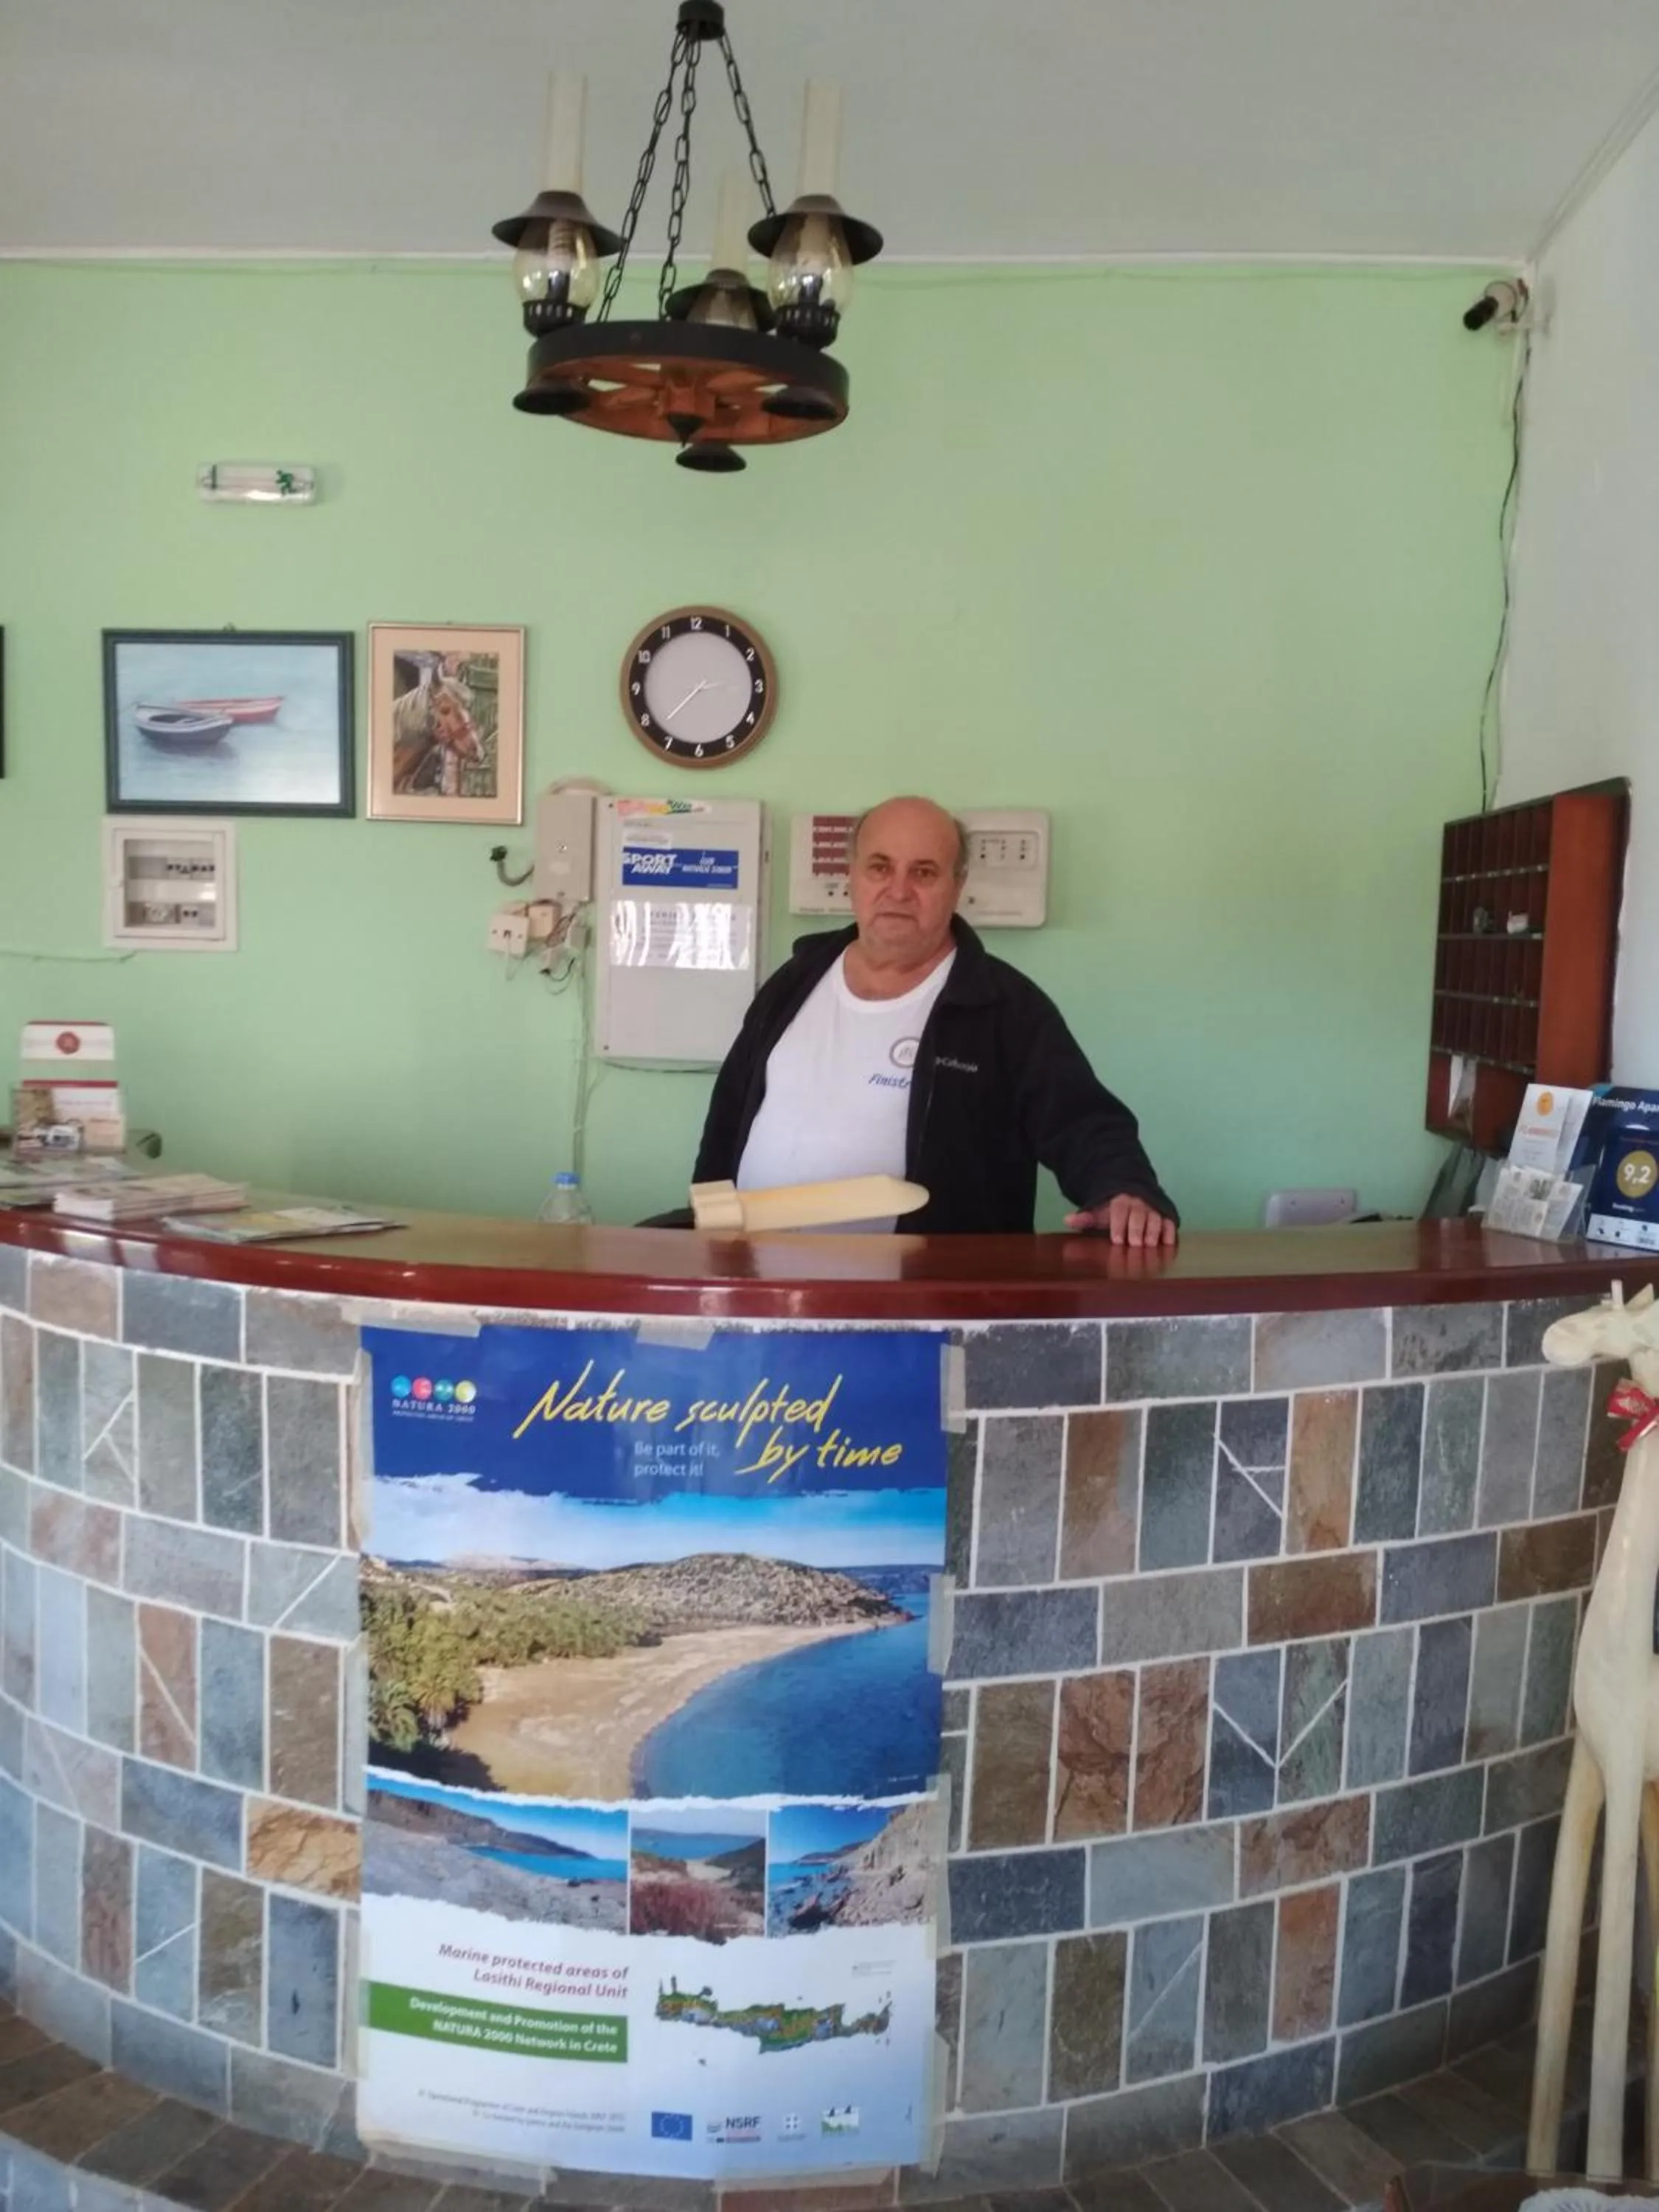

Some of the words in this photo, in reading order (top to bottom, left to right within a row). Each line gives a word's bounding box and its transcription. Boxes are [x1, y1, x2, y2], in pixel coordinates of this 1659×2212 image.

[690, 616, 702, 630] 12
[662, 625, 670, 639] 11
[725, 625, 730, 637] 1
[638, 650, 650, 663] 10
[745, 647, 754, 661] 2
[631, 681, 641, 695] 9
[754, 679, 763, 693] 3
[641, 713, 650, 726] 8
[745, 712, 754, 725] 4
[664, 736, 673, 751] 7
[726, 734, 735, 749] 5
[694, 743, 703, 757] 6
[1624, 1163, 1652, 1184] 9,2
[392, 1398, 444, 1413] NATURA
[513, 1359, 671, 1439] Nature
[674, 1374, 844, 1448] sculpted
[635, 1440, 653, 1456] Be
[655, 1443, 686, 1458] part
[688, 1441, 705, 1457] of
[734, 1425, 810, 1484] by
[817, 1427, 903, 1468] time
[634, 1462, 686, 1478] protect
[438, 1944, 490, 1964] Marine
[491, 1954, 563, 1977] protected
[566, 1964, 609, 1979] areas
[611, 1965, 630, 1980] of
[474, 1969, 522, 1988] Lasithi
[524, 1977, 592, 1997] Regional
[595, 1983, 629, 1998] Unit
[409, 1996, 487, 2021] Development
[489, 2013, 512, 2025] and
[515, 2016, 578, 2034] Promotion
[580, 2021, 597, 2035] of
[597, 2023, 618, 2035] the
[433, 2020, 482, 2039] NATURA
[483, 2028, 514, 2043] 2000
[515, 2034, 568, 2050] Network
[569, 2038, 581, 2050] in
[583, 2039, 618, 2054] Crete
[726, 2116, 761, 2129] NSRF
